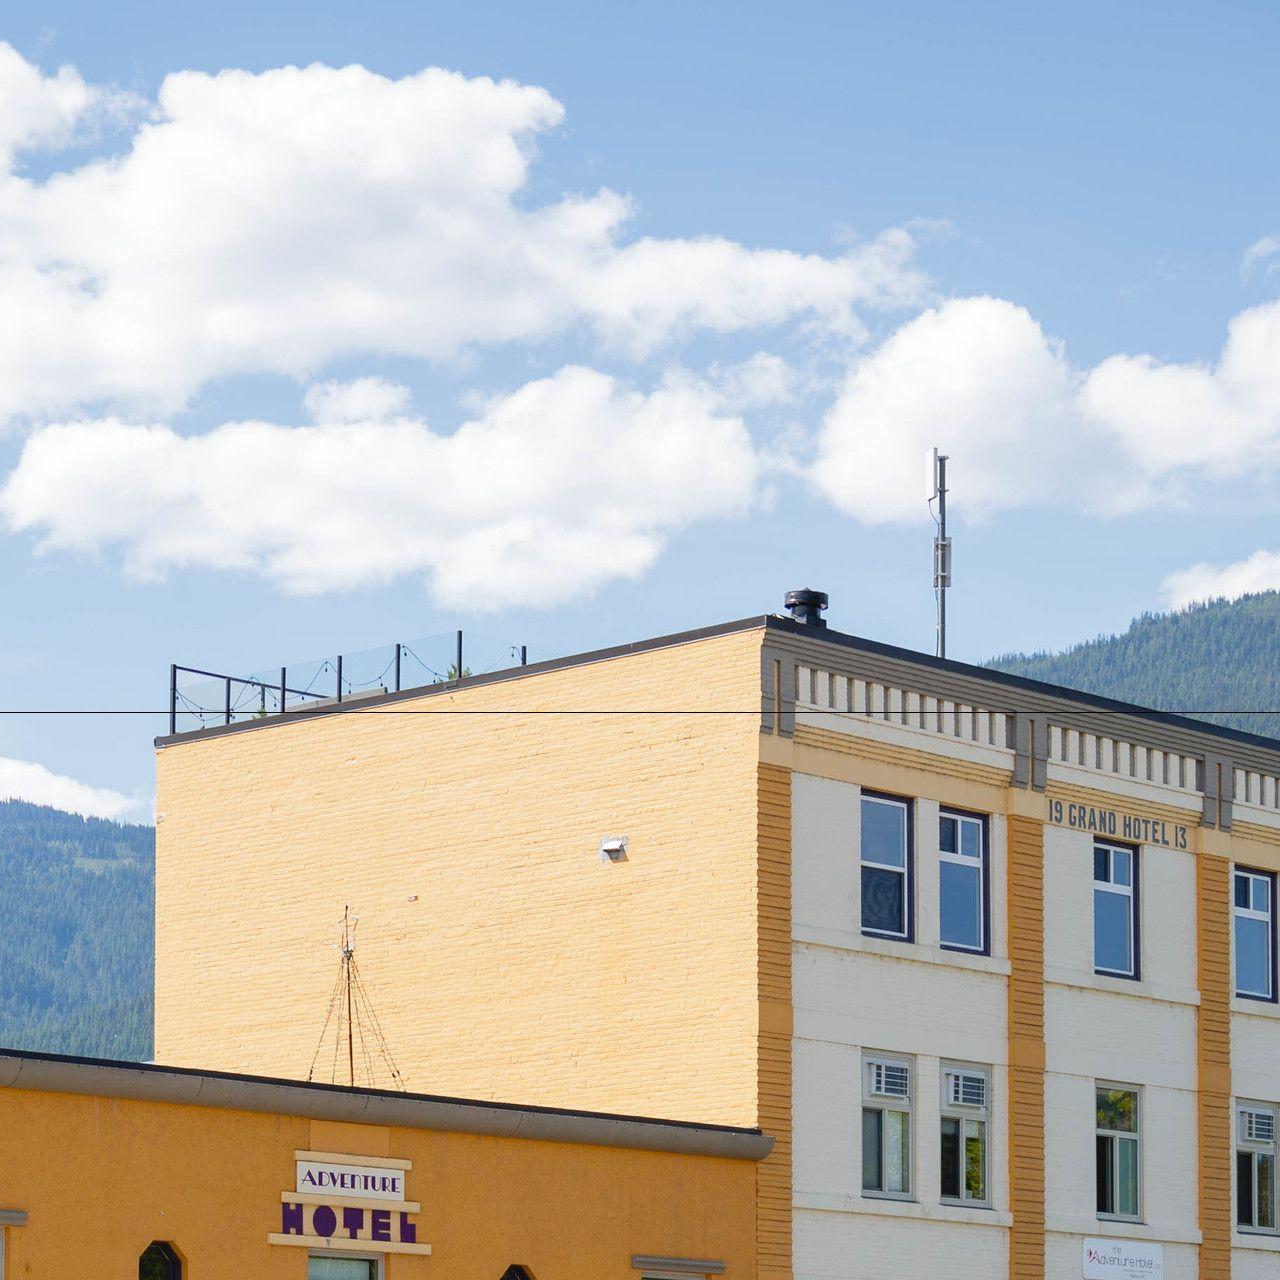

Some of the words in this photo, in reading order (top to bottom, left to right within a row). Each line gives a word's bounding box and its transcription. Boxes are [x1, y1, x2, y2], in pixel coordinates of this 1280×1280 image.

[1048, 799, 1063, 824] 19
[1068, 803, 1116, 835] GRAND
[1123, 814, 1169, 846] HOTEL
[1174, 825, 1187, 849] 13
[300, 1169, 402, 1193] ADVENTURE
[282, 1202, 417, 1244] HOTEL
